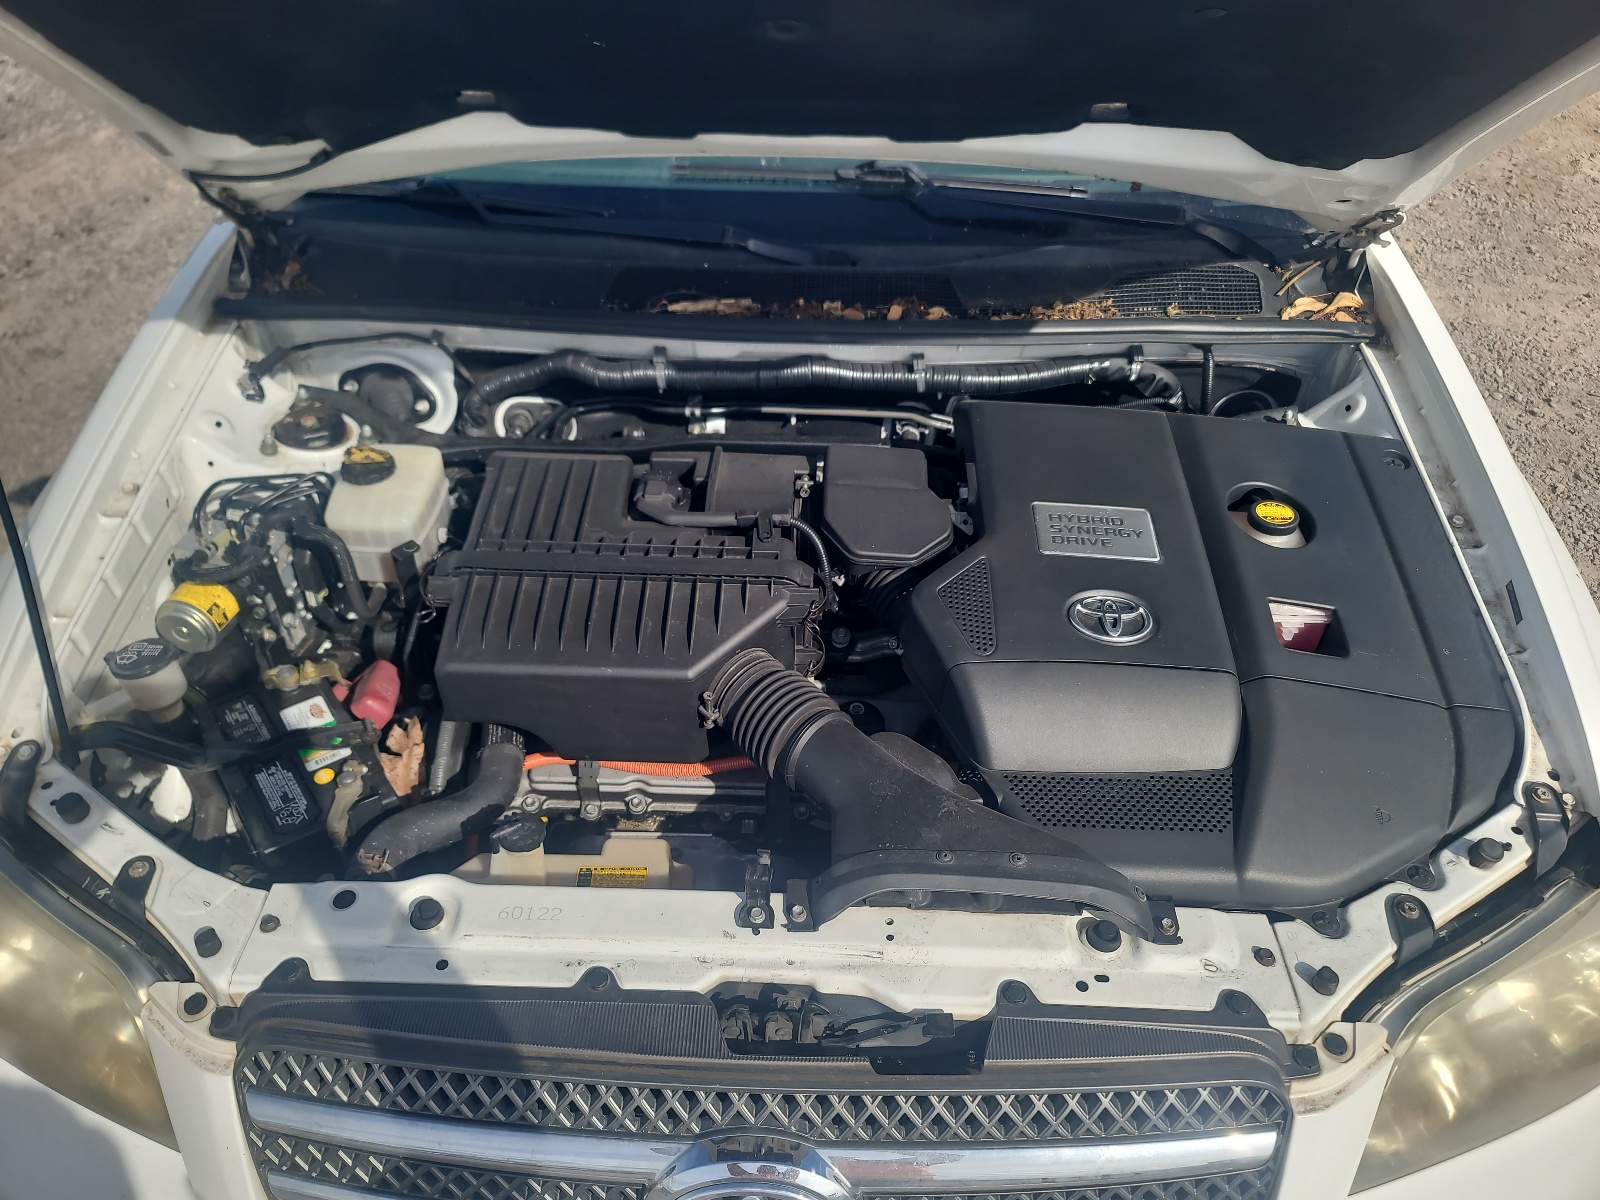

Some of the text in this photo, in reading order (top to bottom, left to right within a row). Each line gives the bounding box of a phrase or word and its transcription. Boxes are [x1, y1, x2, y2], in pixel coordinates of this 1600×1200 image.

[1047, 512, 1124, 526] HYBRID
[1049, 523, 1143, 538] SYNERGY
[1050, 534, 1113, 547] DRIVE
[498, 905, 562, 921] 60122
